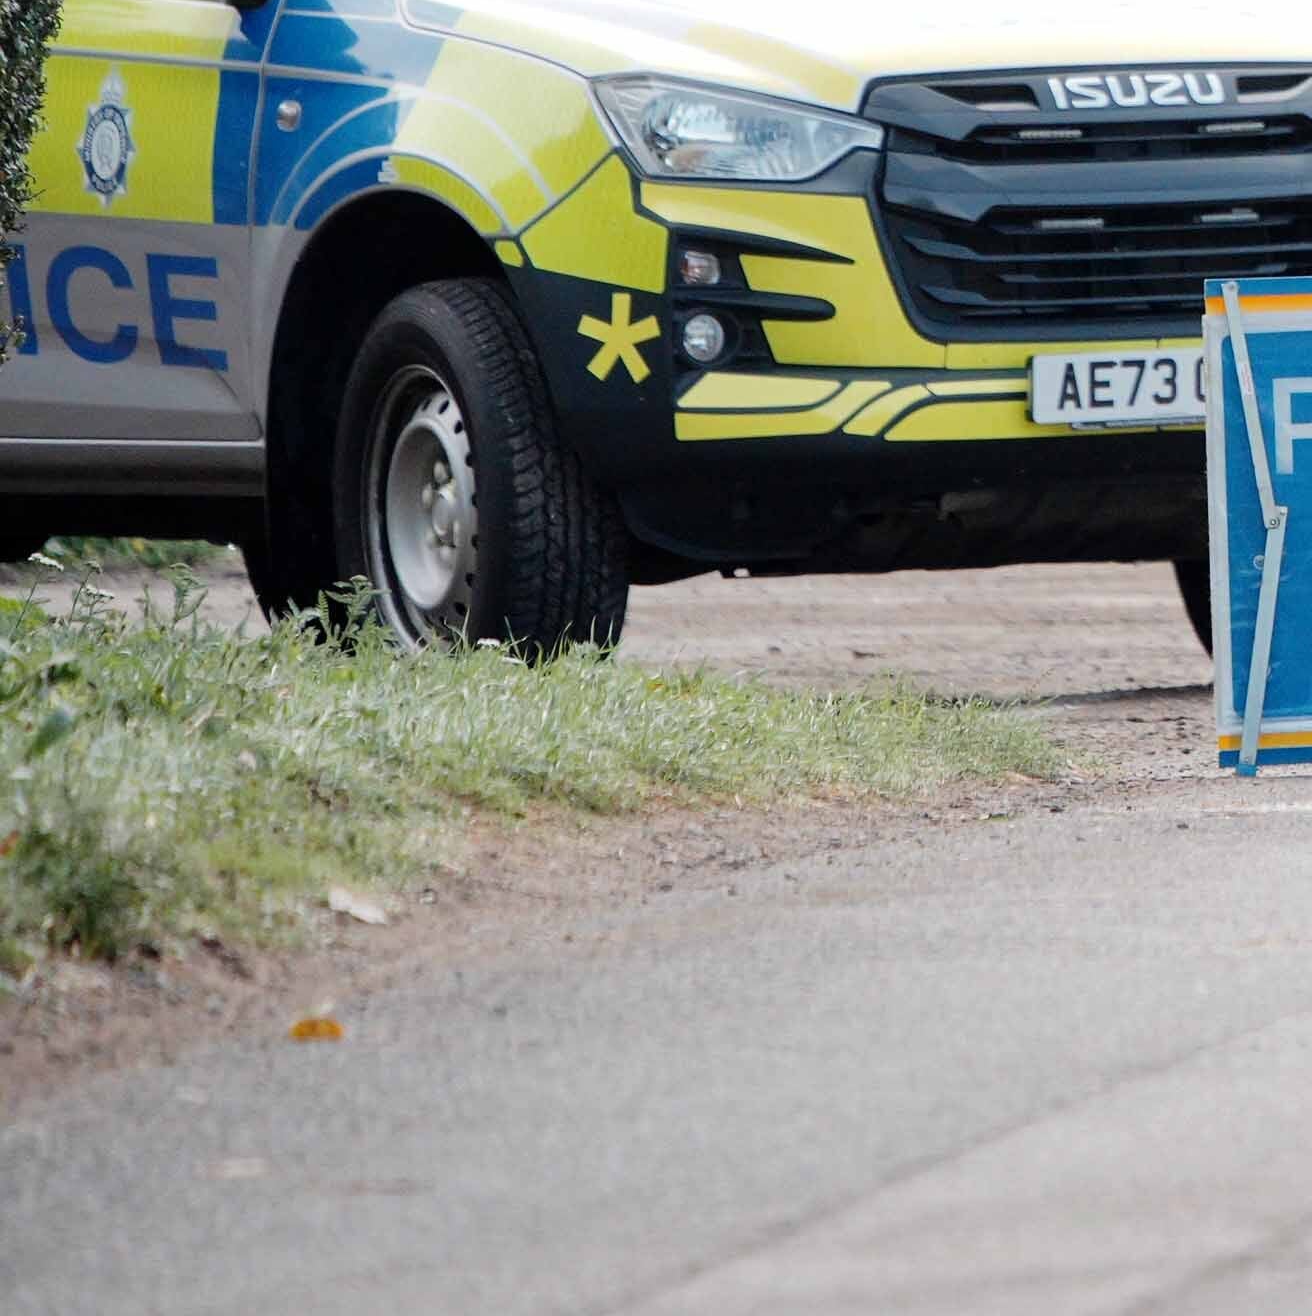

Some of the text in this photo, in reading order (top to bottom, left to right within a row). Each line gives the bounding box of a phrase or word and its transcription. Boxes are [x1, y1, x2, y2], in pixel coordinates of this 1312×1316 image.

[1047, 73, 1226, 111] ISUZU
[5, 243, 229, 372] ICE
[1057, 357, 1178, 410] AE73
